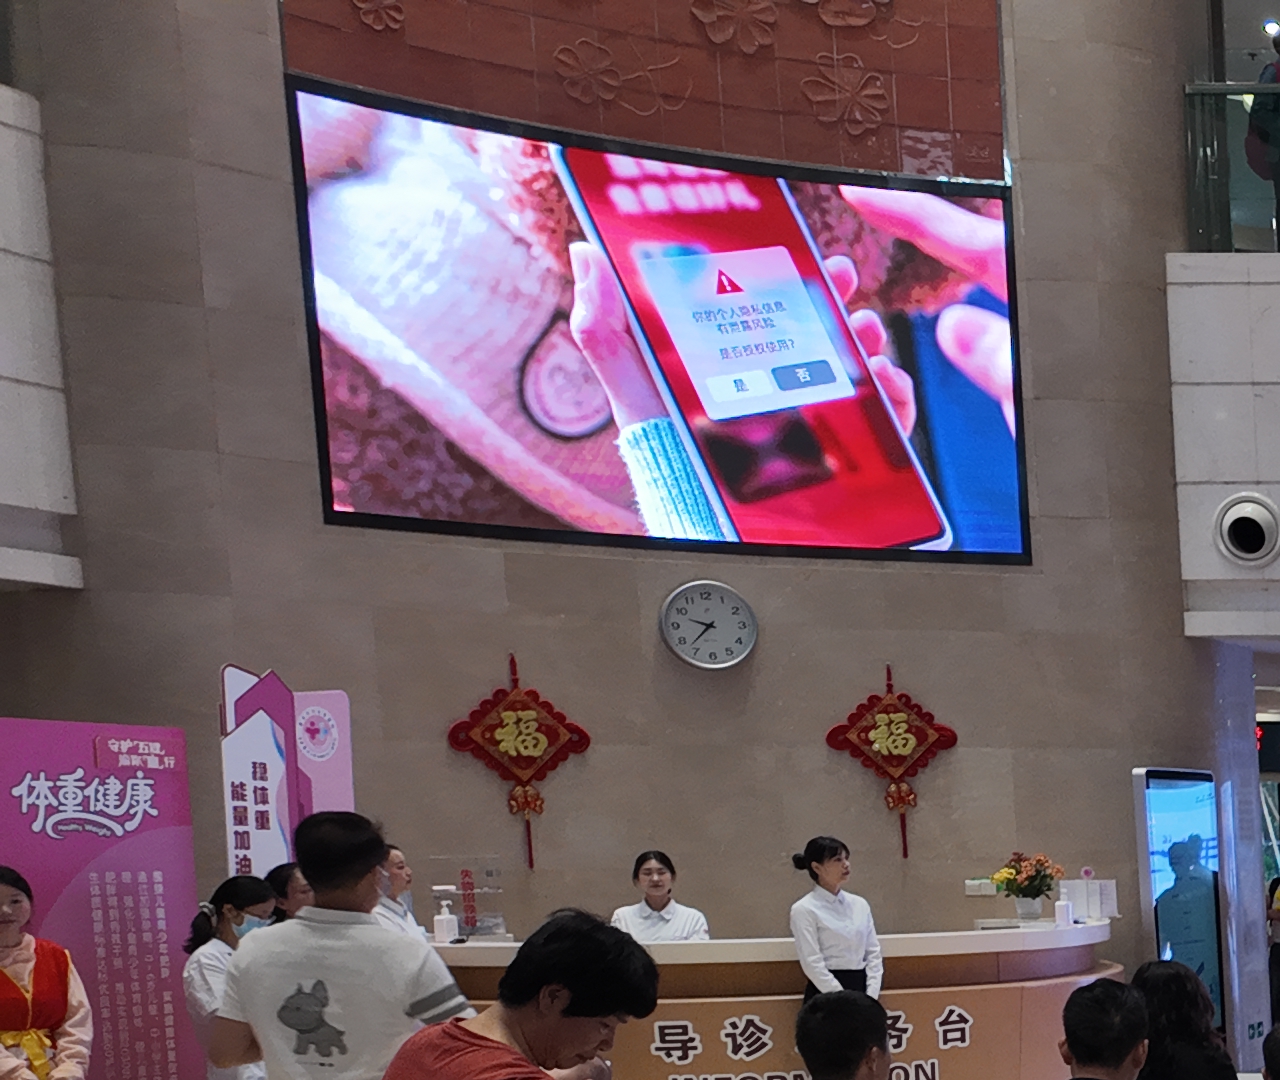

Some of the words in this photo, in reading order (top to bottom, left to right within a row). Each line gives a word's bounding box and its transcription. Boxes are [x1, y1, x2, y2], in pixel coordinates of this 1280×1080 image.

[733, 378, 750, 393] 是
[795, 367, 811, 383] 否
[494, 710, 549, 758] 福
[868, 712, 917, 756] 福
[11, 767, 160, 834] 体重健康
[251, 761, 271, 831] 稳体重
[230, 780, 253, 875] 能量加油
